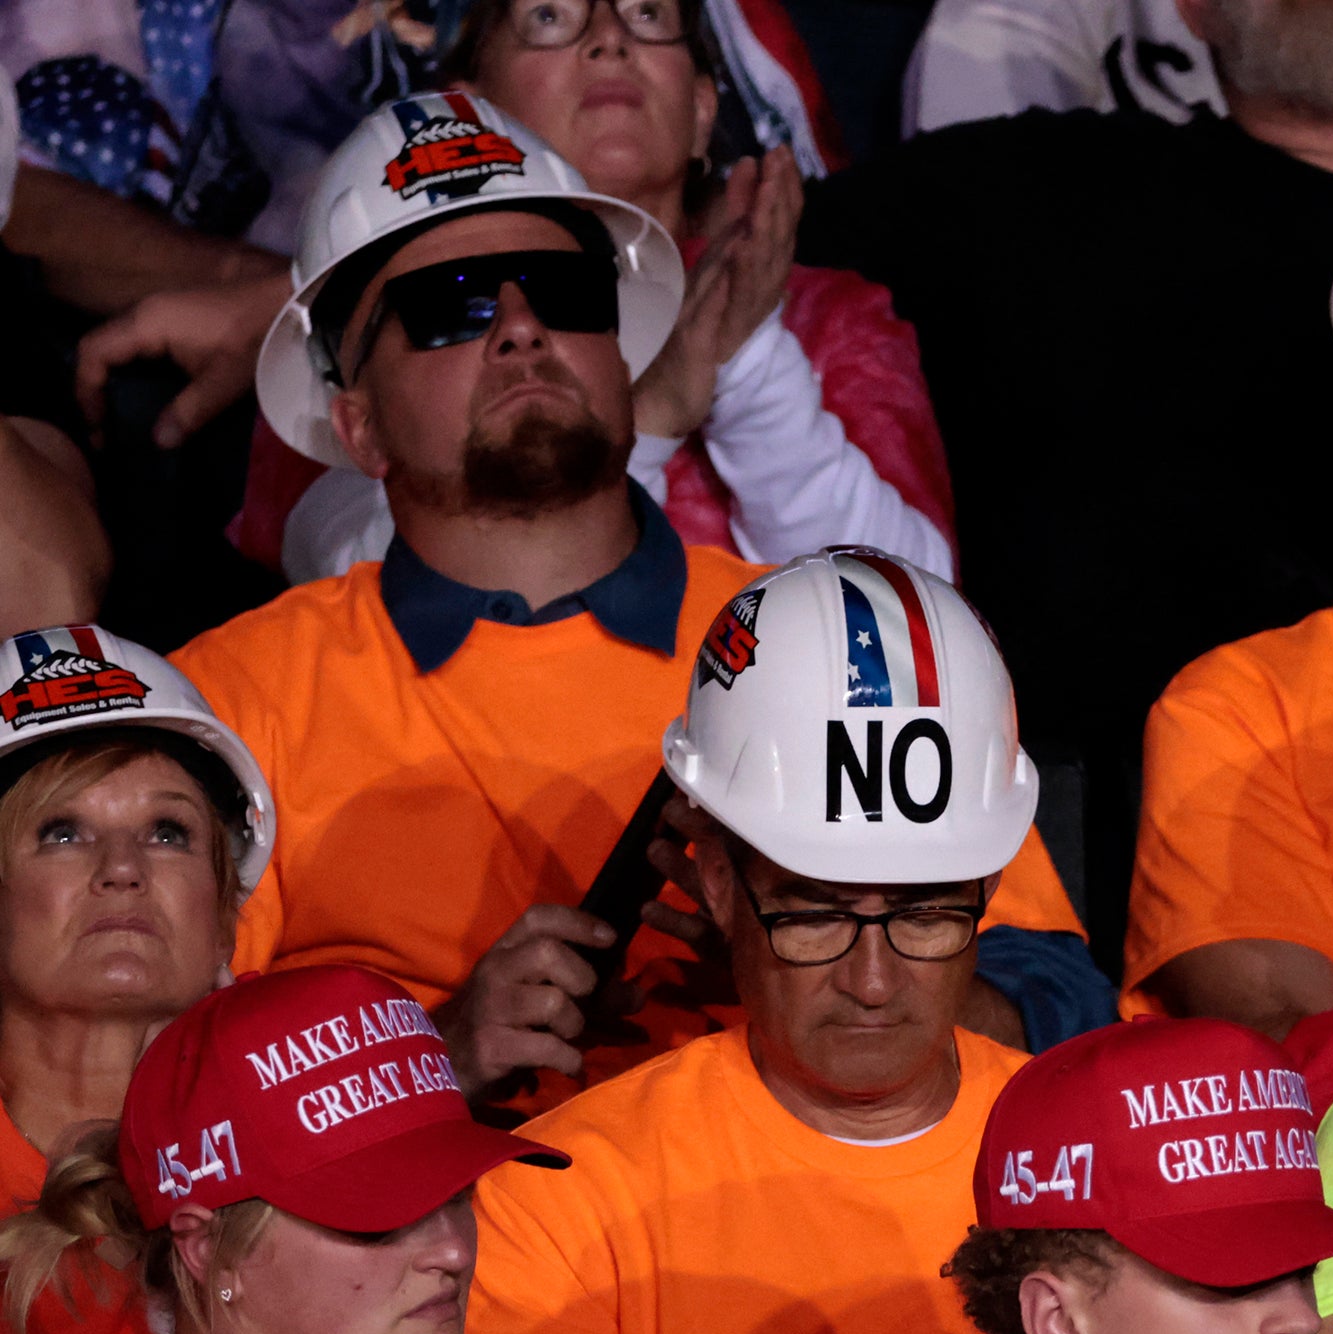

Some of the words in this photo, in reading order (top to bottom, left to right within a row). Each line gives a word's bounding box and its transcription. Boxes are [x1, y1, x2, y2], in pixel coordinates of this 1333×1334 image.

[385, 132, 524, 192] HES
[0, 667, 147, 724] HES
[68, 701, 96, 712] Sales
[98, 699, 106, 707] &
[826, 718, 952, 823] NO
[245, 1015, 359, 1090] MAKE
[296, 1065, 409, 1134] GREAT
[1120, 1074, 1233, 1129] MAKE
[155, 1119, 242, 1200] 45-47
[999, 1143, 1094, 1204] 45-47
[1157, 1129, 1269, 1184] GREAT
